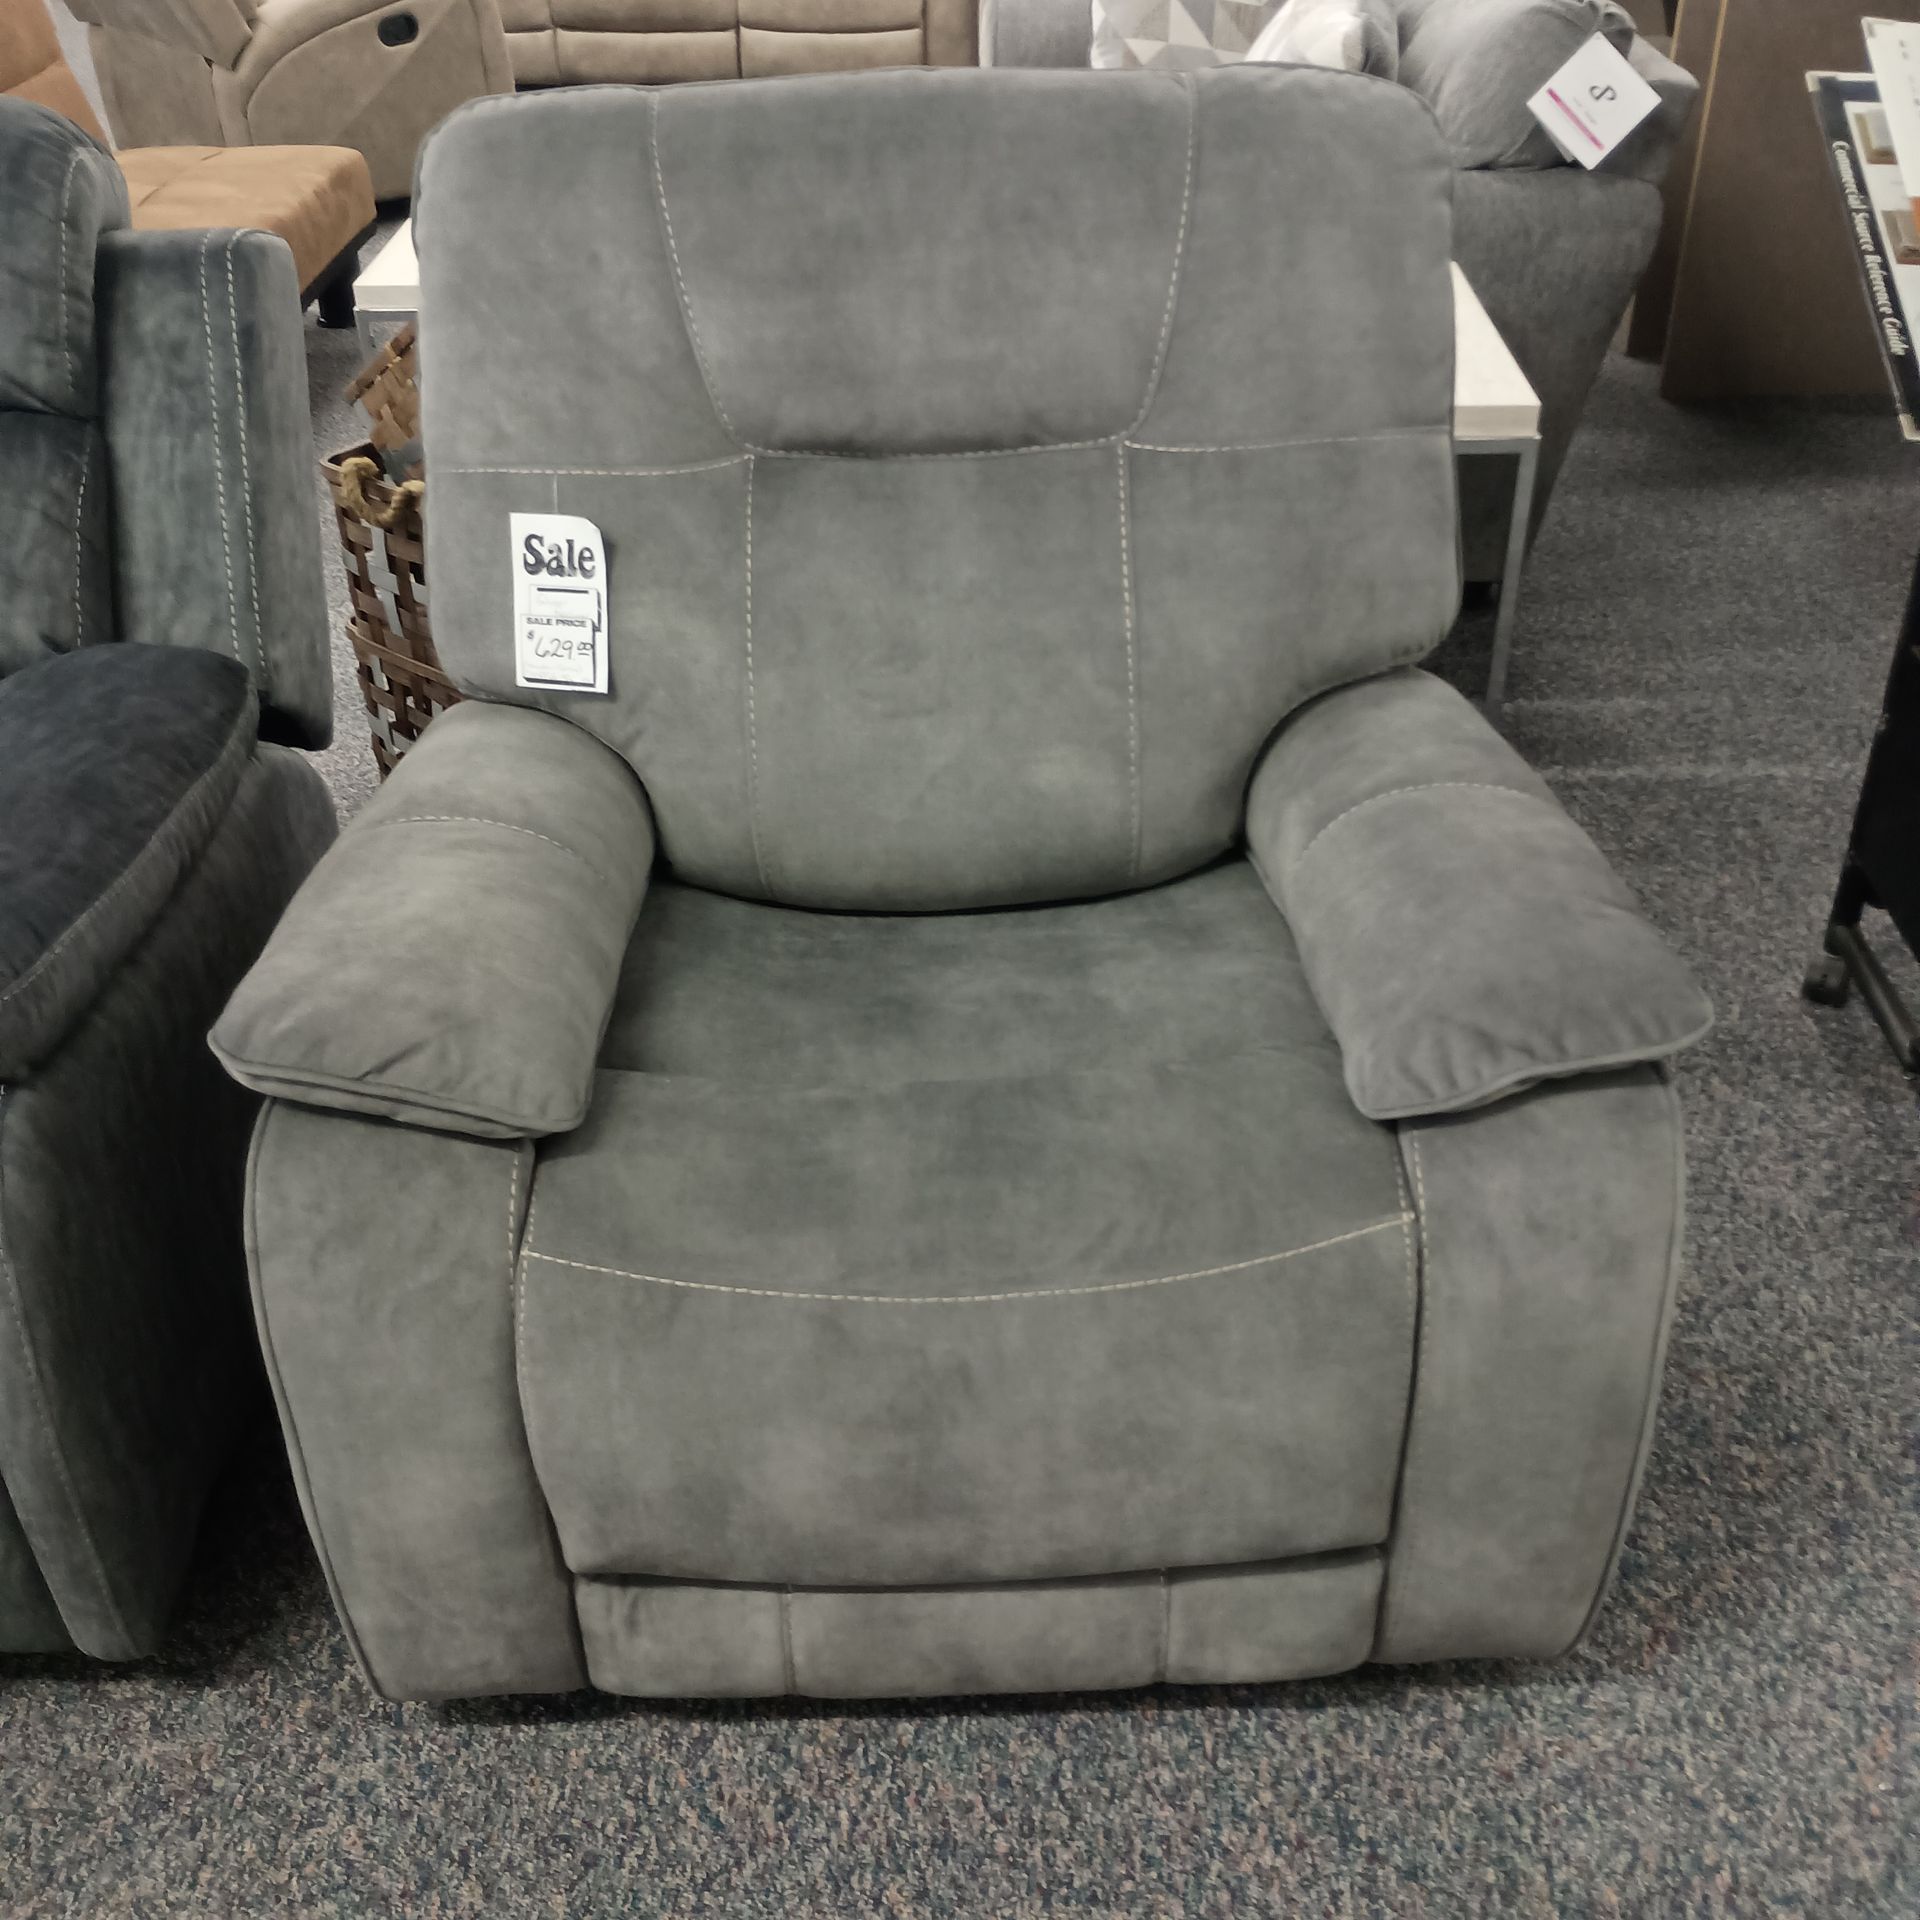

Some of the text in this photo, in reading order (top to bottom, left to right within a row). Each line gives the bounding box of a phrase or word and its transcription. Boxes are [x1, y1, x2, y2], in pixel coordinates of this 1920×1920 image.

[1832, 141, 1909, 356] Commercial Source Reference Guide
[523, 533, 595, 579] Sale
[526, 617, 587, 628] SALE PRICE
